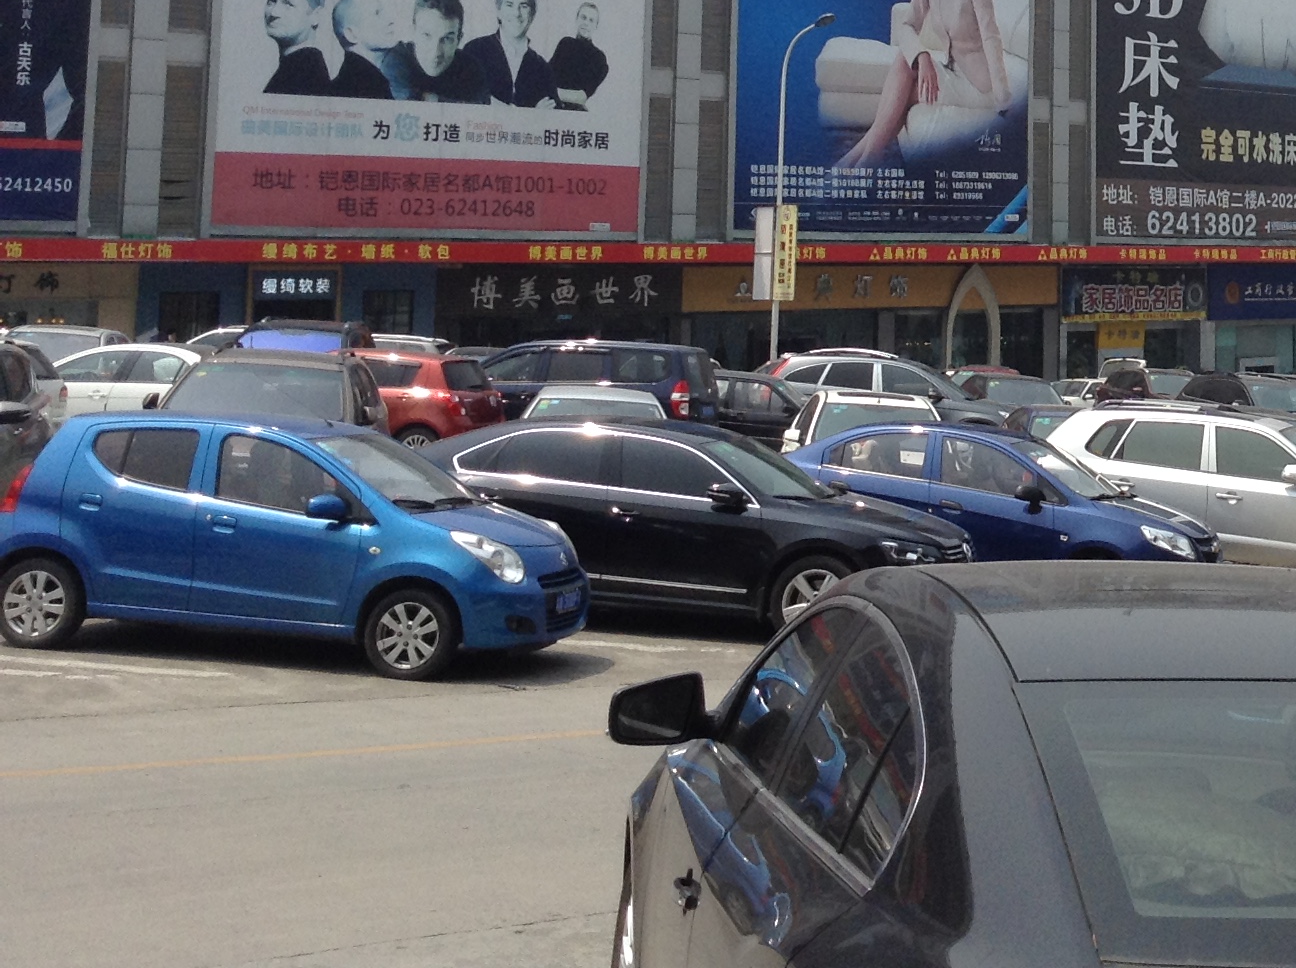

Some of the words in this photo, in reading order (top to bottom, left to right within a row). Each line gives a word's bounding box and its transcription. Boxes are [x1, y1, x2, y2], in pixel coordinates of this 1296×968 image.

[16, 41, 33, 86] 古天乐
[543, 129, 610, 150] 时尚家居
[0, 241, 23, 259] 饰
[102, 242, 173, 260] 福仕灯饰
[528, 245, 604, 261] 博美画世界
[643, 245, 708, 261] 博美画世界
[883, 246, 928, 261] 晶典灯饰
[959, 246, 1001, 261] 晶典灯饰
[470, 274, 659, 310] 博美画世界
[1082, 283, 1185, 313] 家居饰品名店
